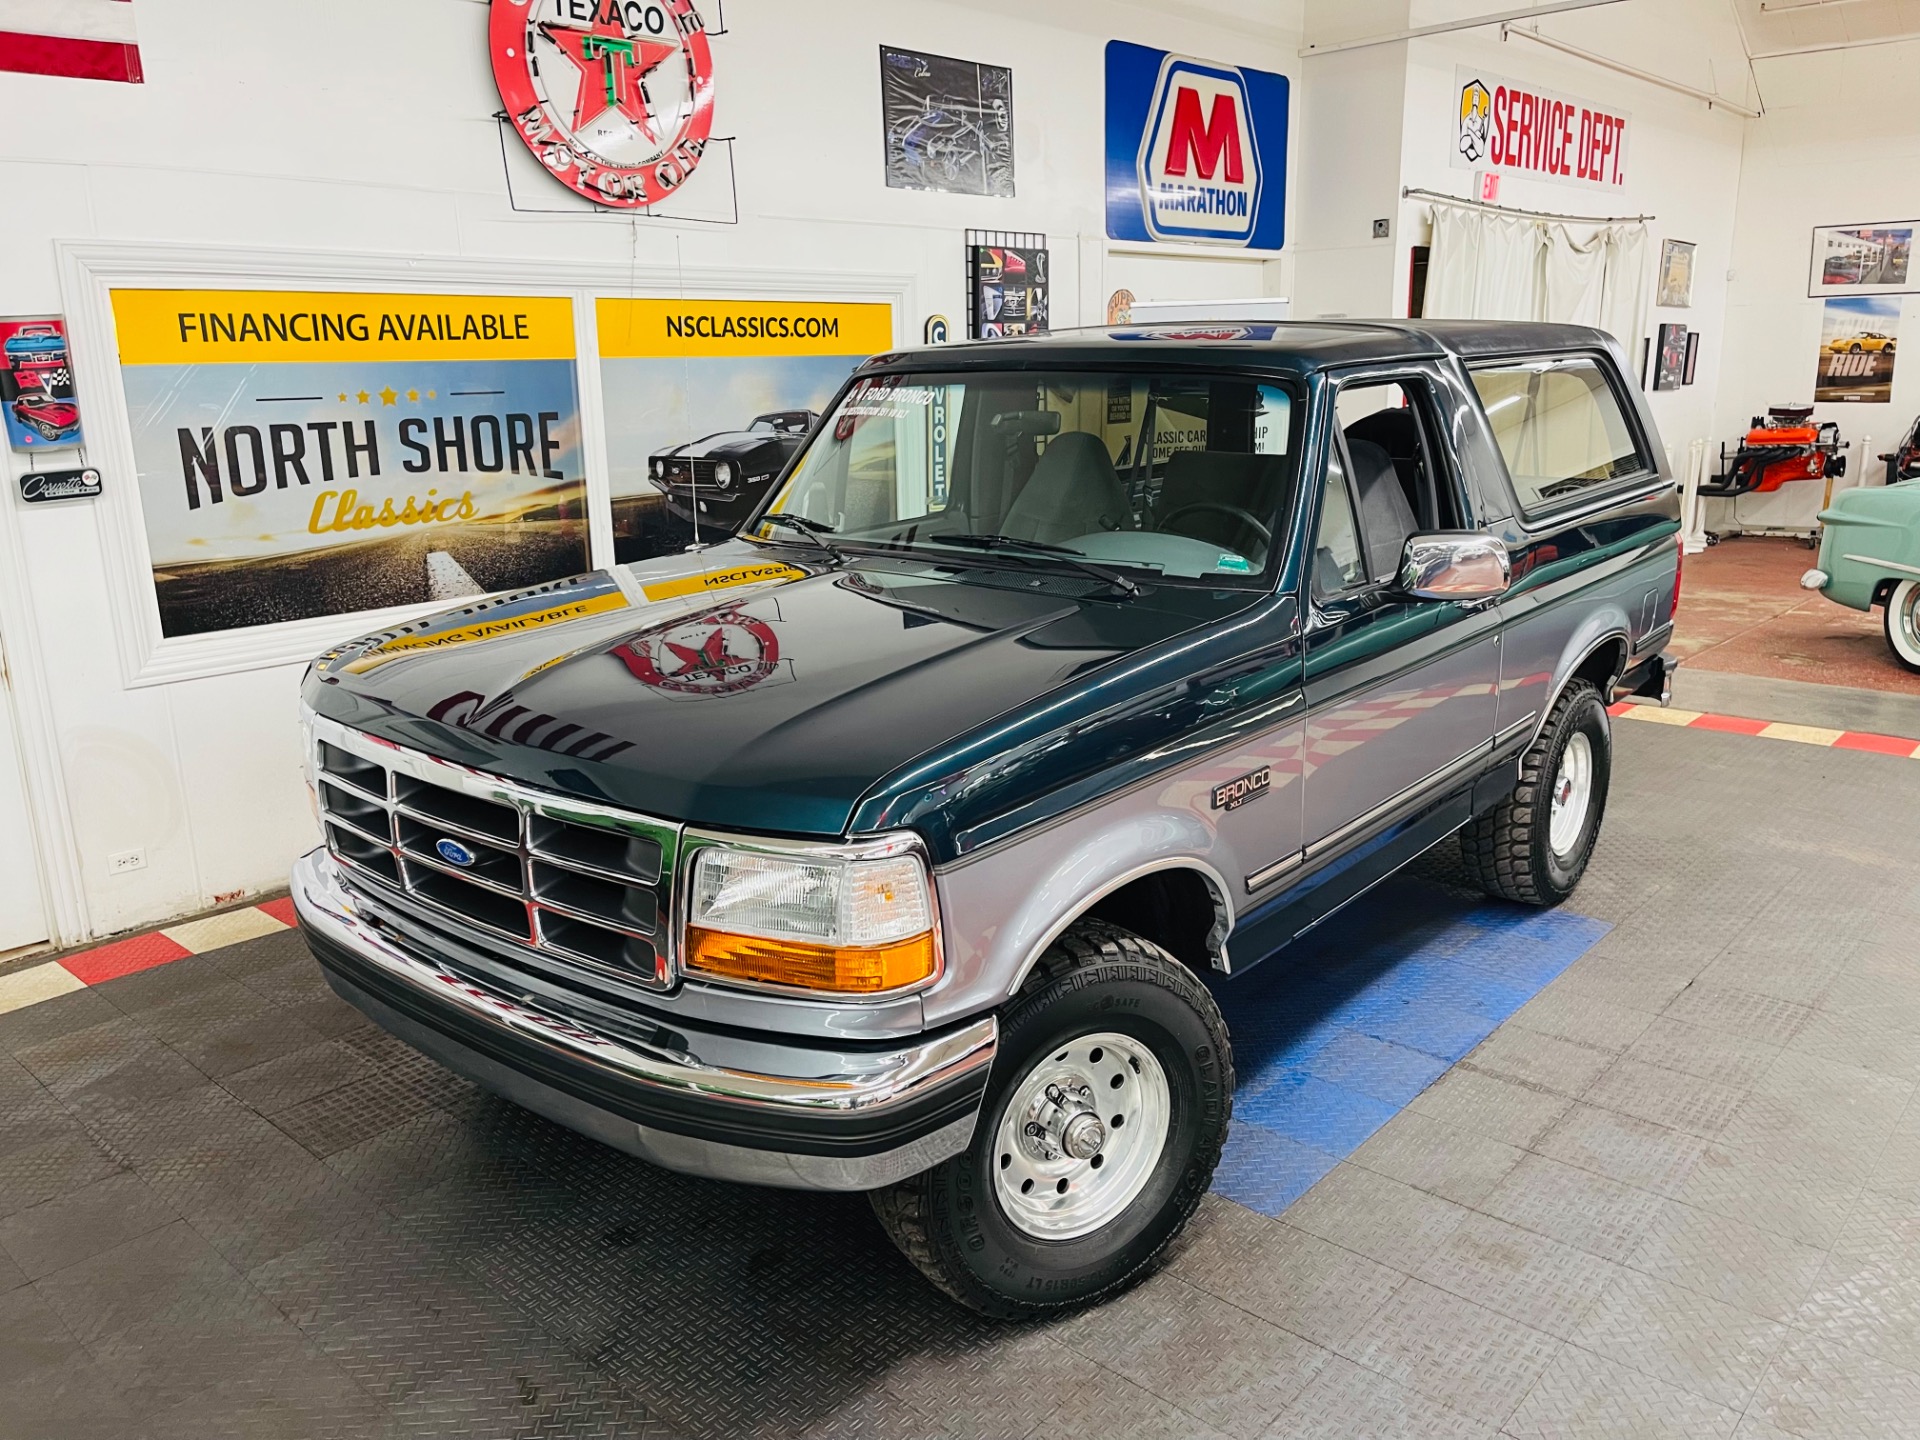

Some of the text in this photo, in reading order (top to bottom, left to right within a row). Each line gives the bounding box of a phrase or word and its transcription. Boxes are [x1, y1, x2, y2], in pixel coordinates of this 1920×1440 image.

[556, 0, 664, 34] TEXACO
[1164, 86, 1244, 184] M
[1491, 85, 1625, 185] SERVICE DEPT.
[516, 105, 708, 203] MOTOR OIL
[1159, 183, 1247, 217] MARATHON
[178, 312, 529, 343] FINANCING AVAILABLE
[666, 315, 839, 338] NSCLASSICS.COM
[1827, 353, 1877, 377] RIDE
[862, 387, 891, 401] FORD
[887, 387, 935, 406] BRONCO
[177, 412, 564, 510] NORTH SHORE
[22, 475, 86, 499] Corvette
[308, 488, 480, 535] Classics
[1216, 768, 1271, 807] BRONCO
[1229, 797, 1244, 809] XLT
[443, 844, 464, 861] Ford
